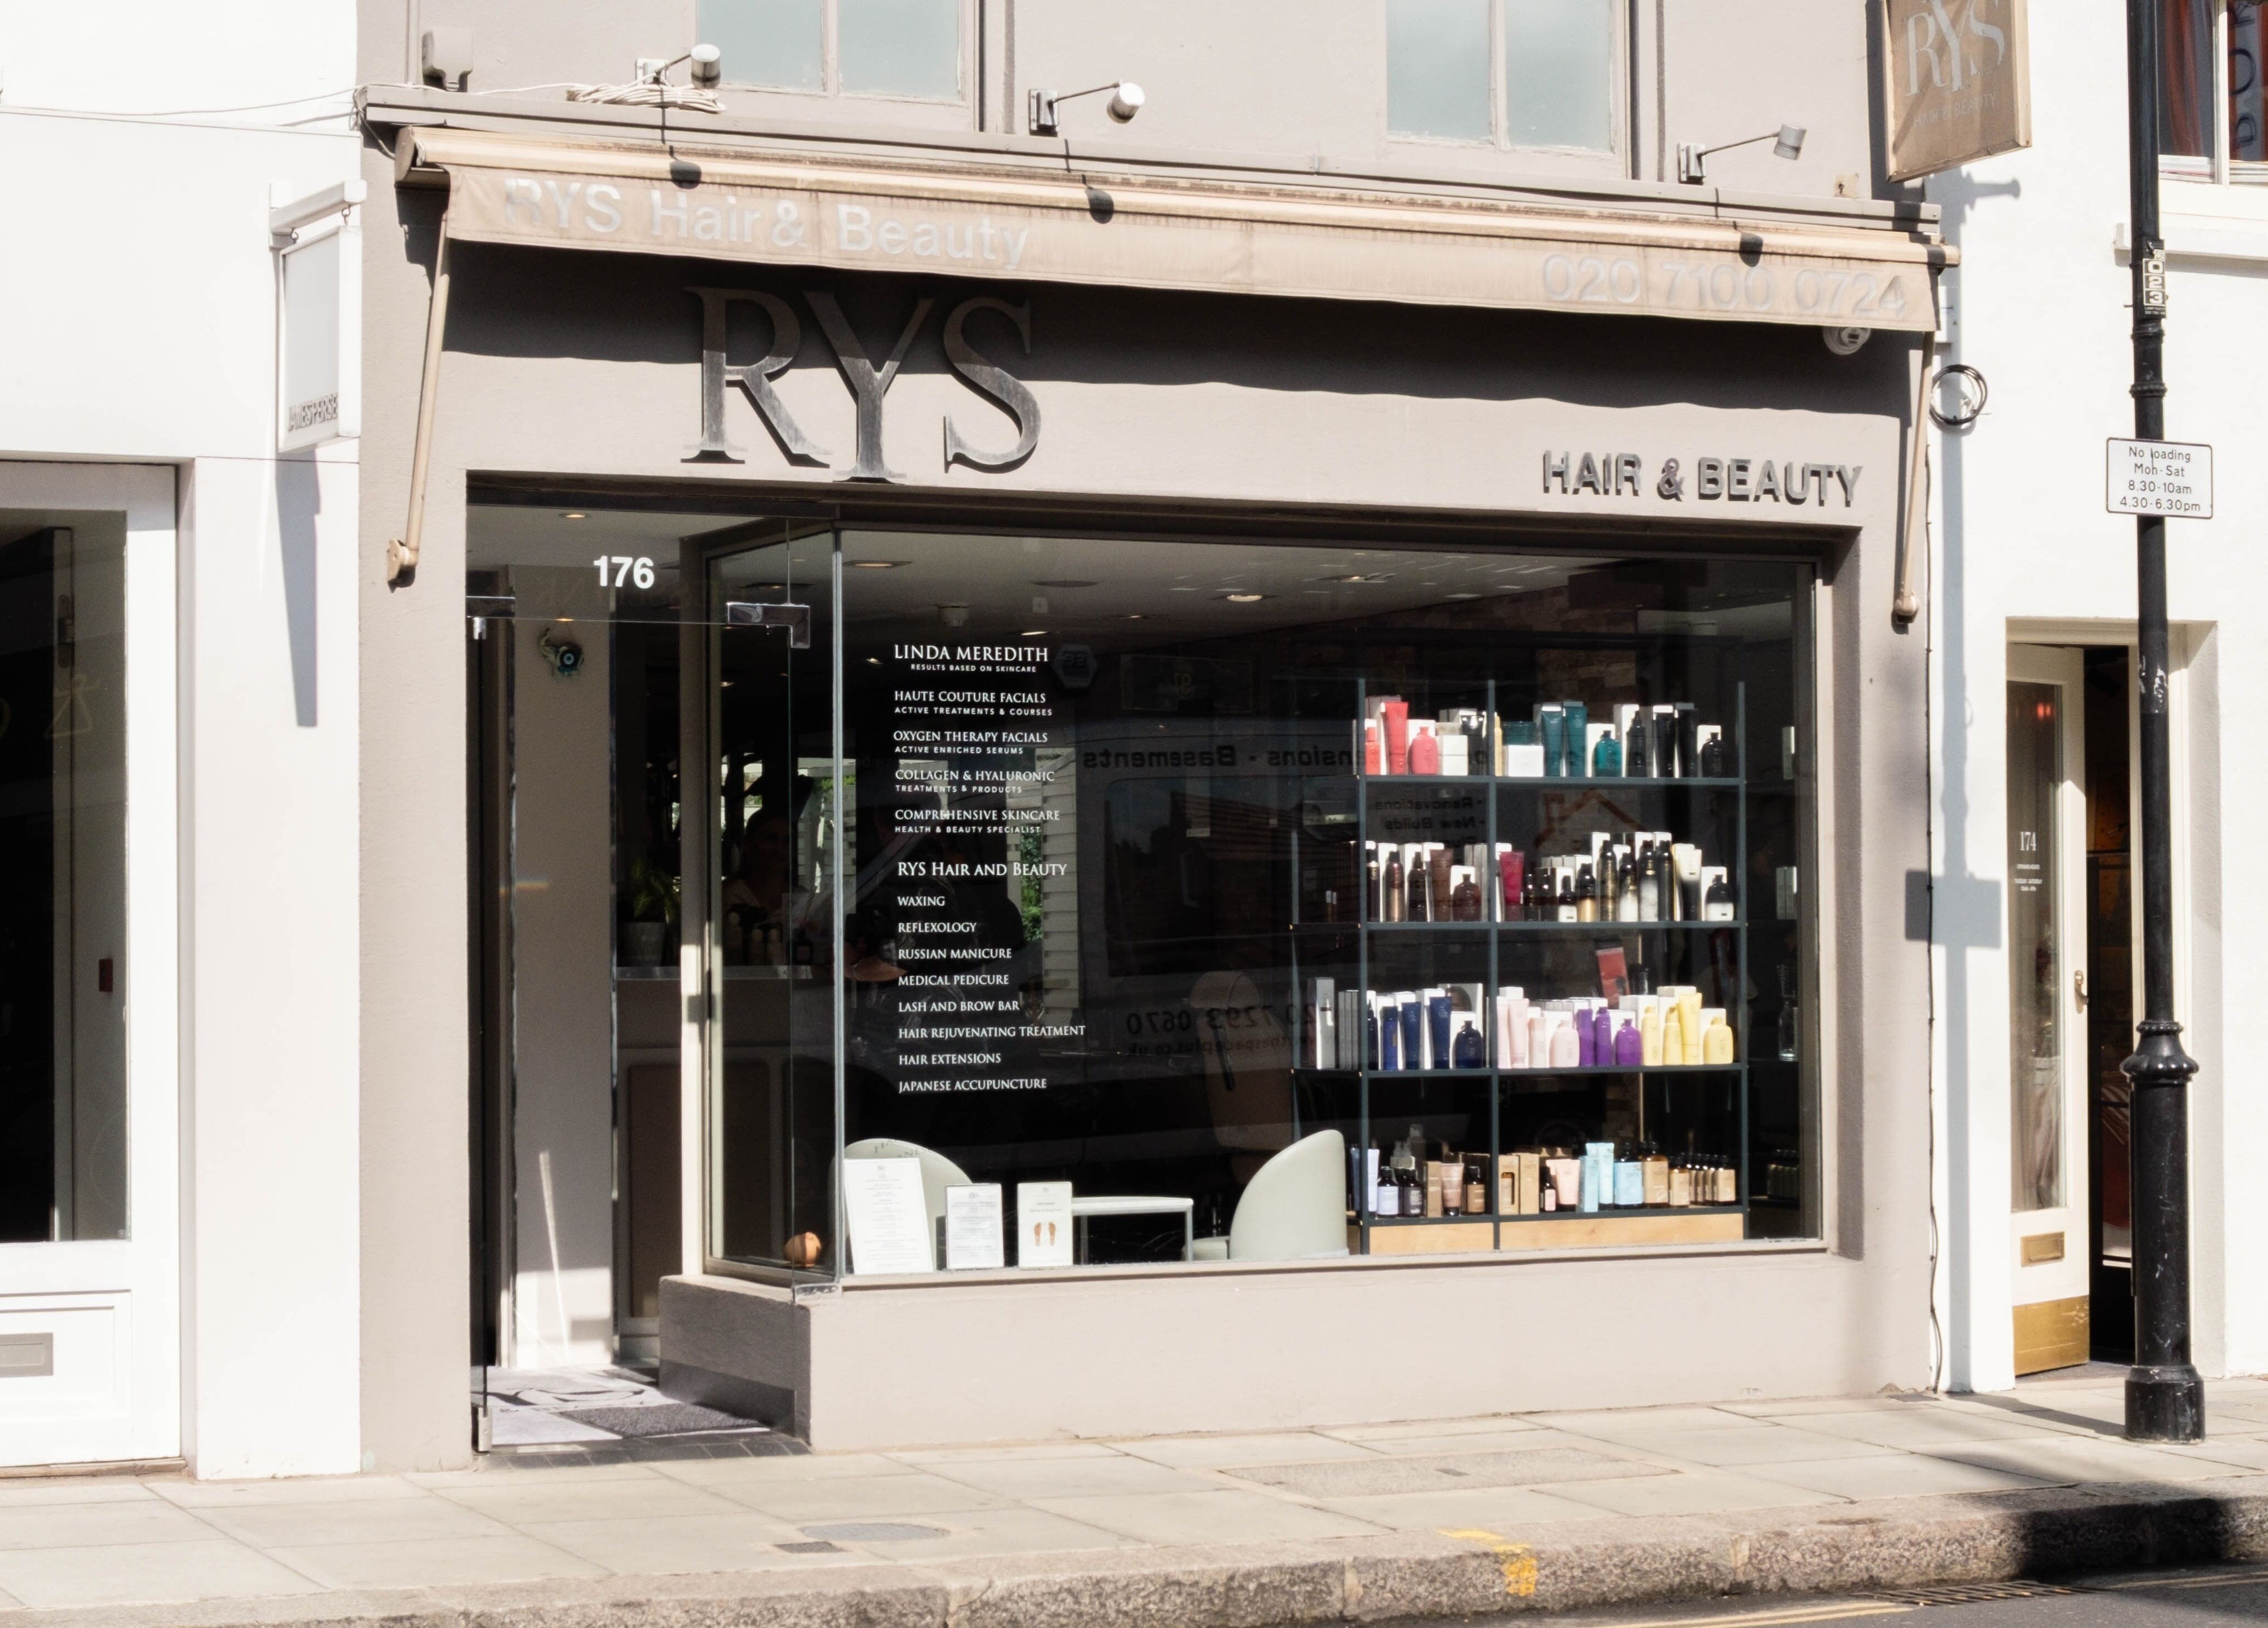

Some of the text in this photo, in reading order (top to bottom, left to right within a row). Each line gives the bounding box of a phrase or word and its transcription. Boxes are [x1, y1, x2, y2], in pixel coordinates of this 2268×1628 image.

[1904, 0, 2005, 96] RYS
[504, 177, 1028, 269] RYS Hair & Beauty
[1542, 254, 1908, 318] 020 7100 0724
[682, 285, 1042, 484] RYS
[2129, 447, 2145, 457] No
[1543, 449, 1863, 507] HAIR & BEAUTY
[594, 555, 654, 589] 176
[894, 644, 950, 660] LINDA
[957, 647, 1049, 662] MEREDITH
[895, 691, 1046, 703] HAUTE COUTURE FACIALS
[894, 731, 1048, 743] OXYGEN THERAPY FACIALS
[895, 770, 1055, 781] COLLAGEN & HYALURONIC
[895, 809, 1060, 820] COMPREHENSIVE SKINCARE
[2021, 832, 2036, 851] 174
[898, 862, 926, 876] RYS
[898, 896, 946, 906] WAXING
[898, 923, 977, 932] REFLEXOLOGY
[898, 948, 1012, 959] RUSSIAN MANICURE
[898, 975, 1009, 986] MEDICAL PEDICURE
[898, 1001, 1019, 1012] LASH AND BROW BAR
[898, 1025, 1086, 1040] HAIR REJUVENATING TREATMENT
[899, 1054, 1001, 1065] HAIR EXTENSIONS
[899, 1079, 1047, 1093] JAPANESE ACCUPUNCTURE
